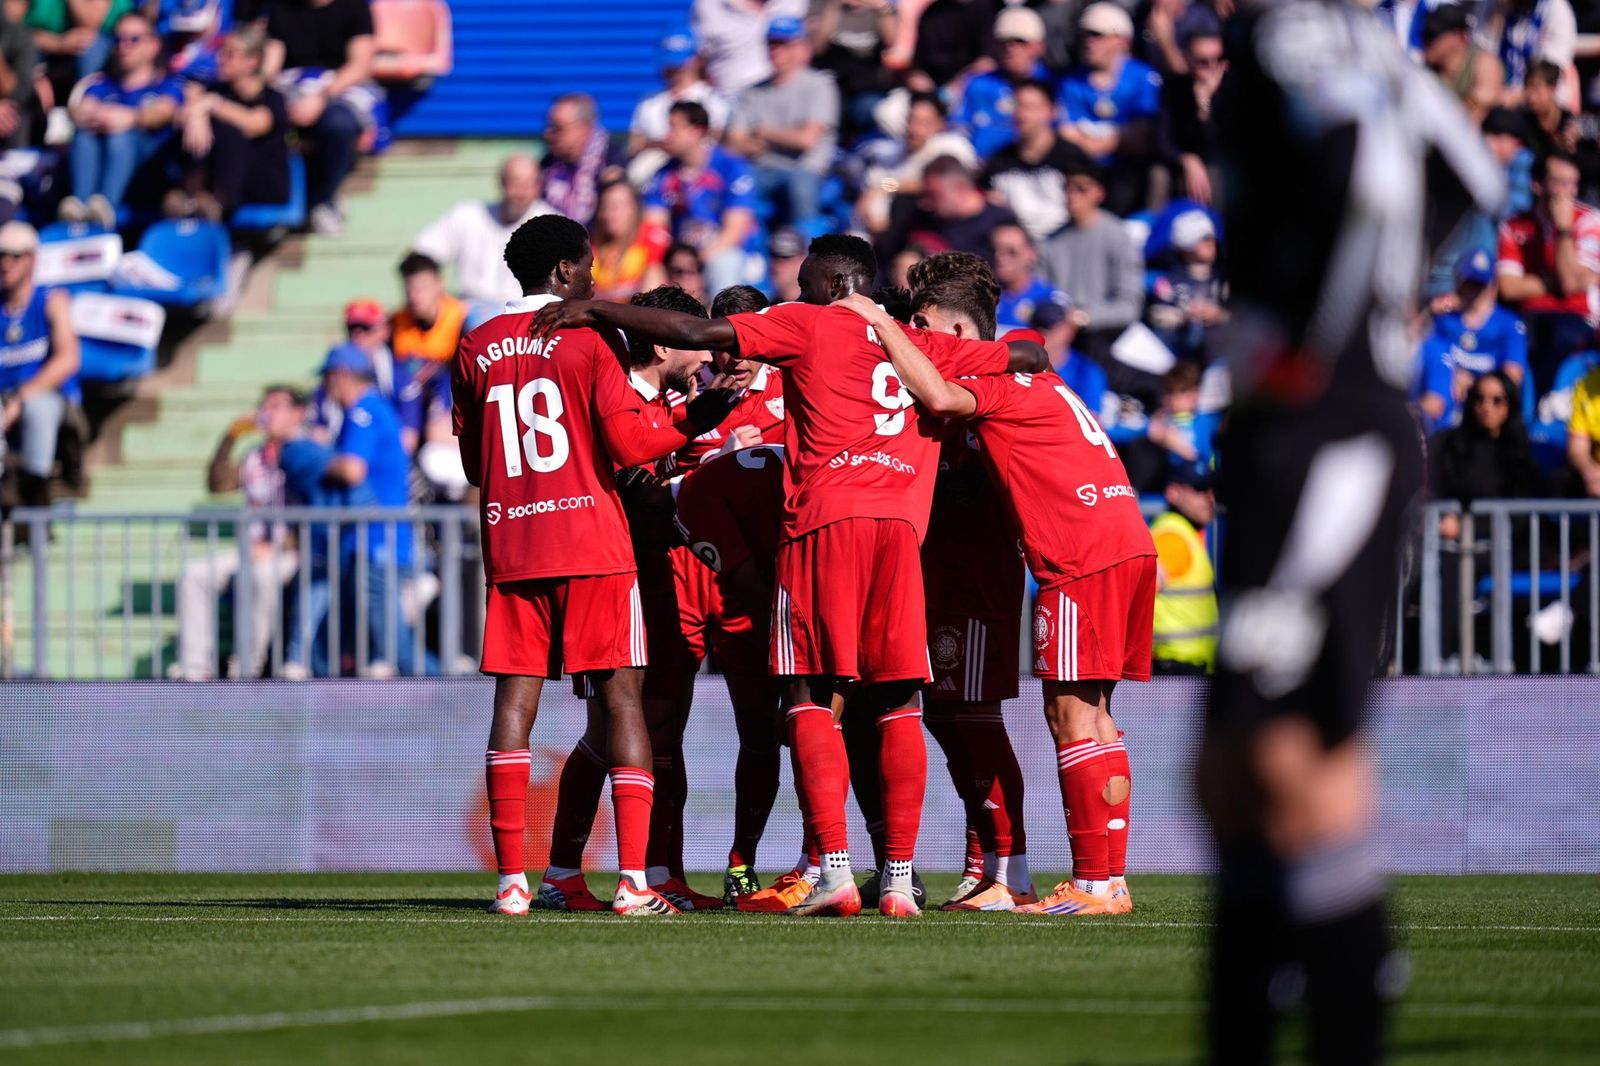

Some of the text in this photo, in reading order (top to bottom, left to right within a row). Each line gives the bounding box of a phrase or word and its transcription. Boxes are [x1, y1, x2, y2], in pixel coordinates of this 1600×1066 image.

[476, 336, 562, 373] AGOUMÉ
[486, 377, 570, 478] 18
[872, 361, 914, 436] 9
[1053, 385, 1117, 459] 4
